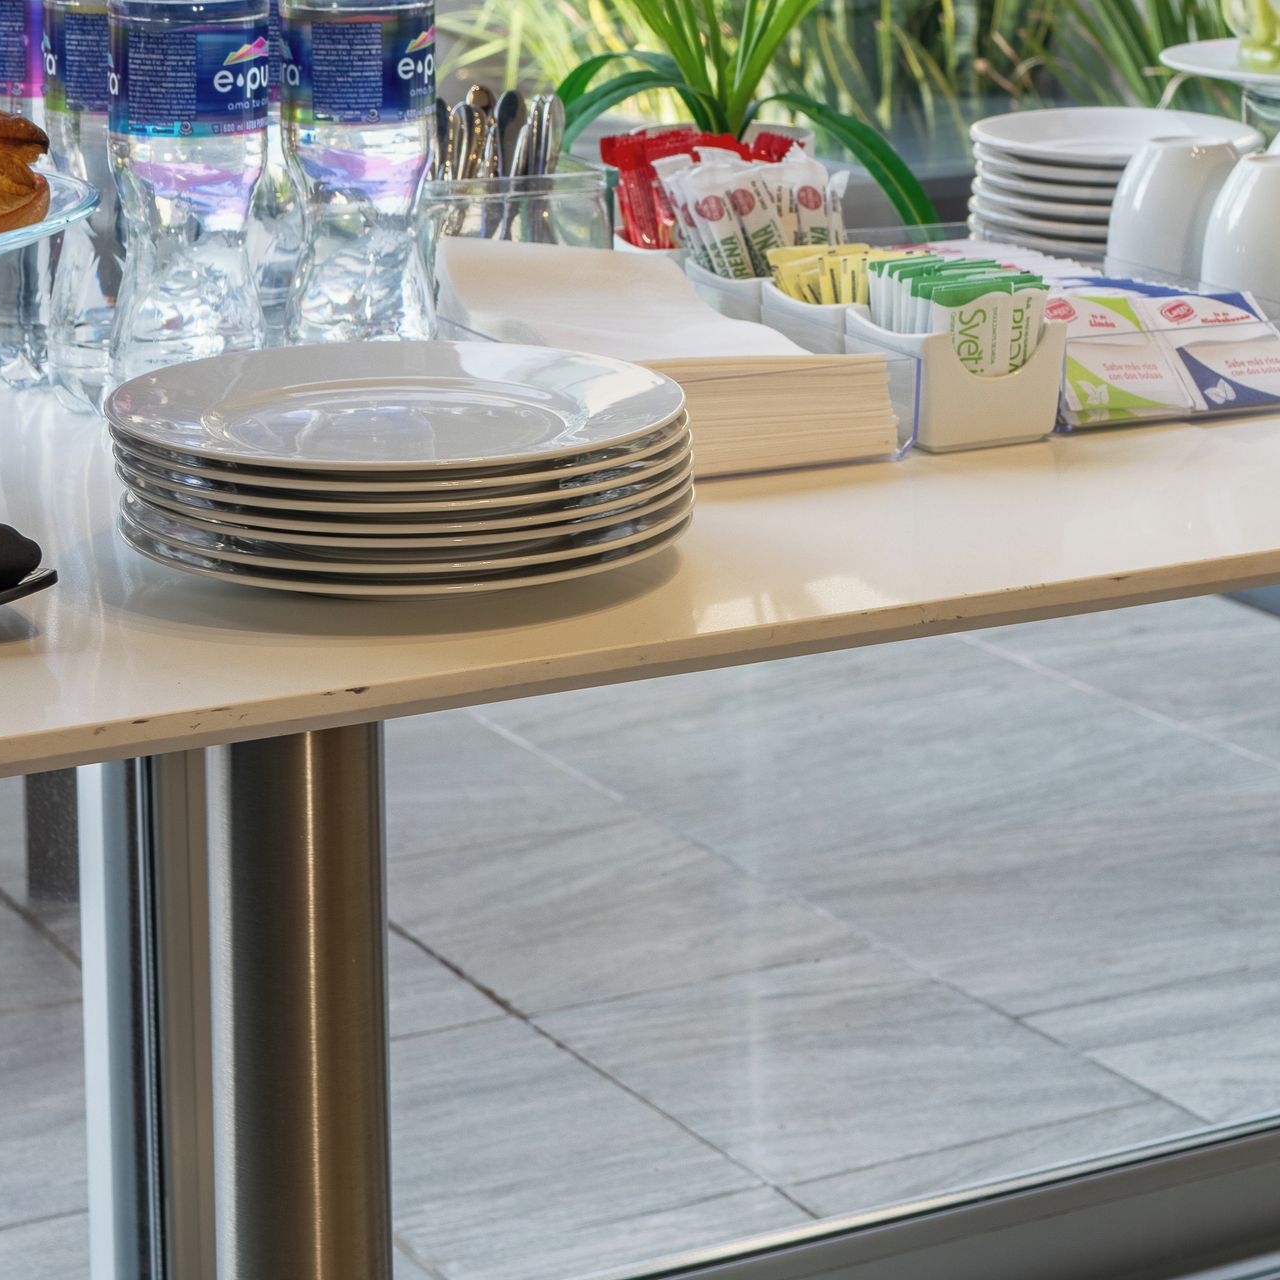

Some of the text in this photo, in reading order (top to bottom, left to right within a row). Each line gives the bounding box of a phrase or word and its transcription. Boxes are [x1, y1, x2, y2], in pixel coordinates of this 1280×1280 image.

[227, 101, 250, 111] ama
[1089, 320, 1116, 328] Limón
[1102, 361, 1123, 371] Sabe
[1142, 362, 1158, 370] rico
[1225, 358, 1246, 369] Sabe
[1265, 355, 1280, 364] rico
[1232, 369, 1245, 377] con
